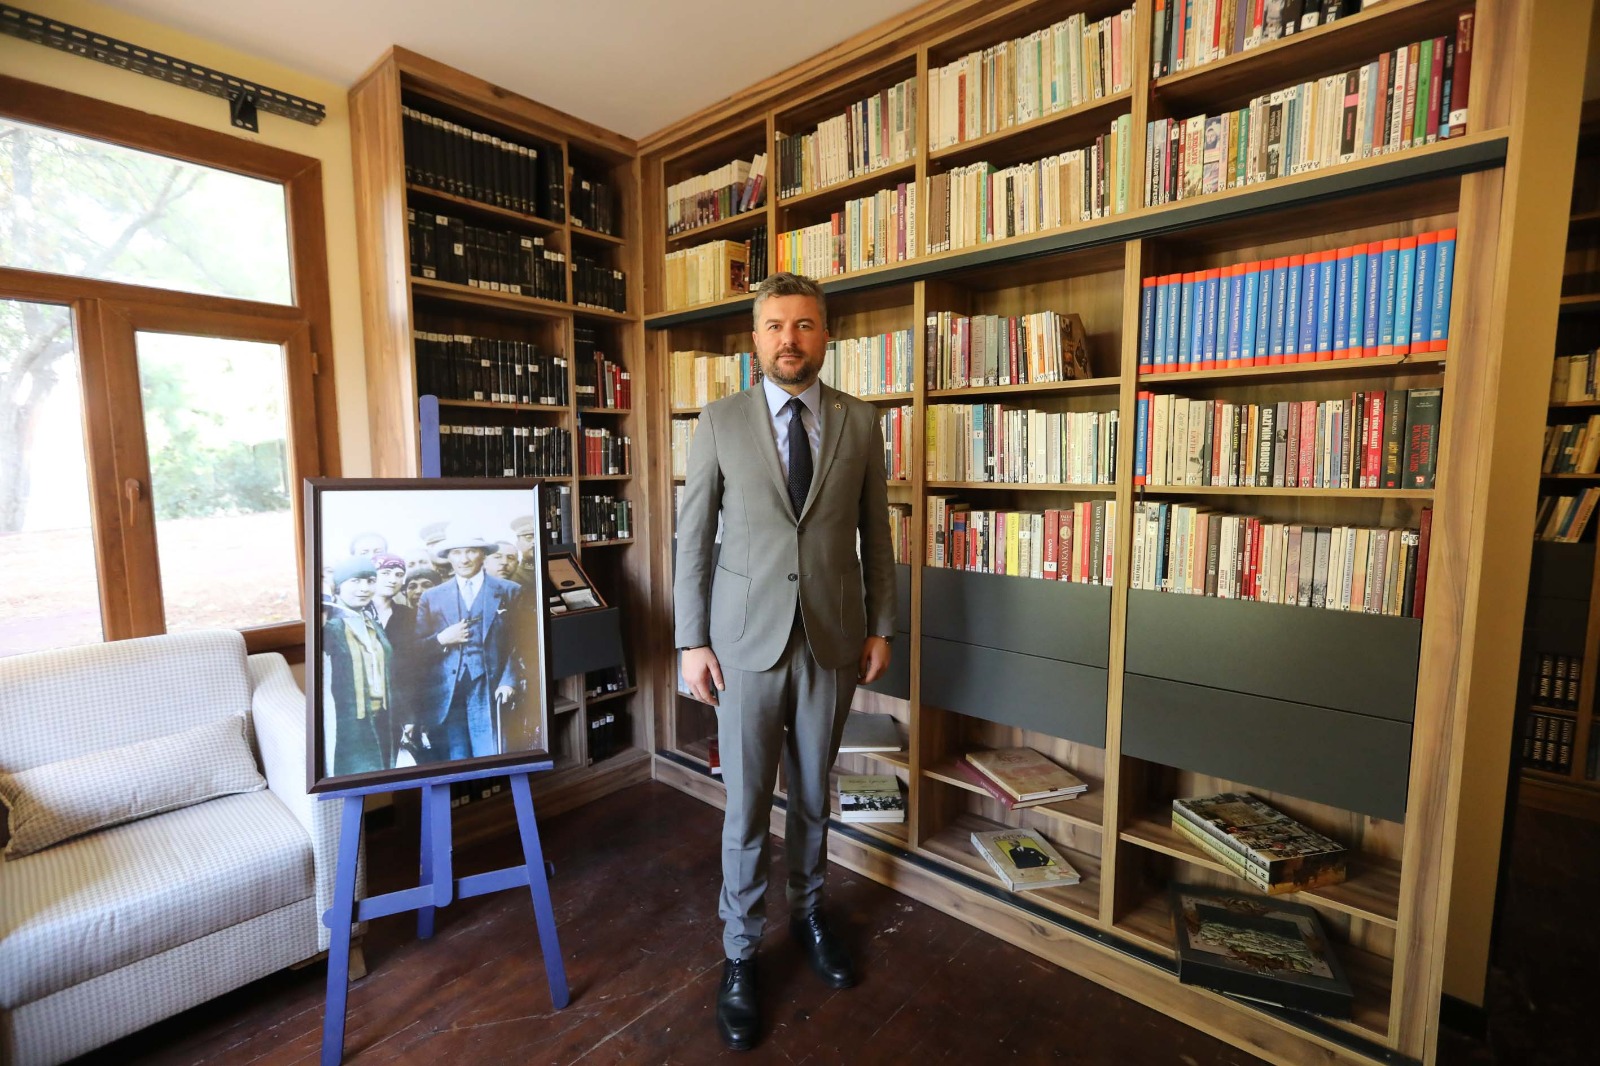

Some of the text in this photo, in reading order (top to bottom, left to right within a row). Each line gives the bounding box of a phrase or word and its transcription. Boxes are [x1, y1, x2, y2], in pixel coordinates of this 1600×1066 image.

[1259, 408, 1274, 472] GAZİ'NİN ORDUSU
[1540, 677, 1551, 697] NUTUK
[1553, 679, 1564, 699] NUTUK
[1568, 681, 1577, 701] NUTUK
[1533, 740, 1542, 760] NUTUK
[1546, 742, 1556, 762] NUTUK
[1559, 745, 1570, 764] NUTUK
